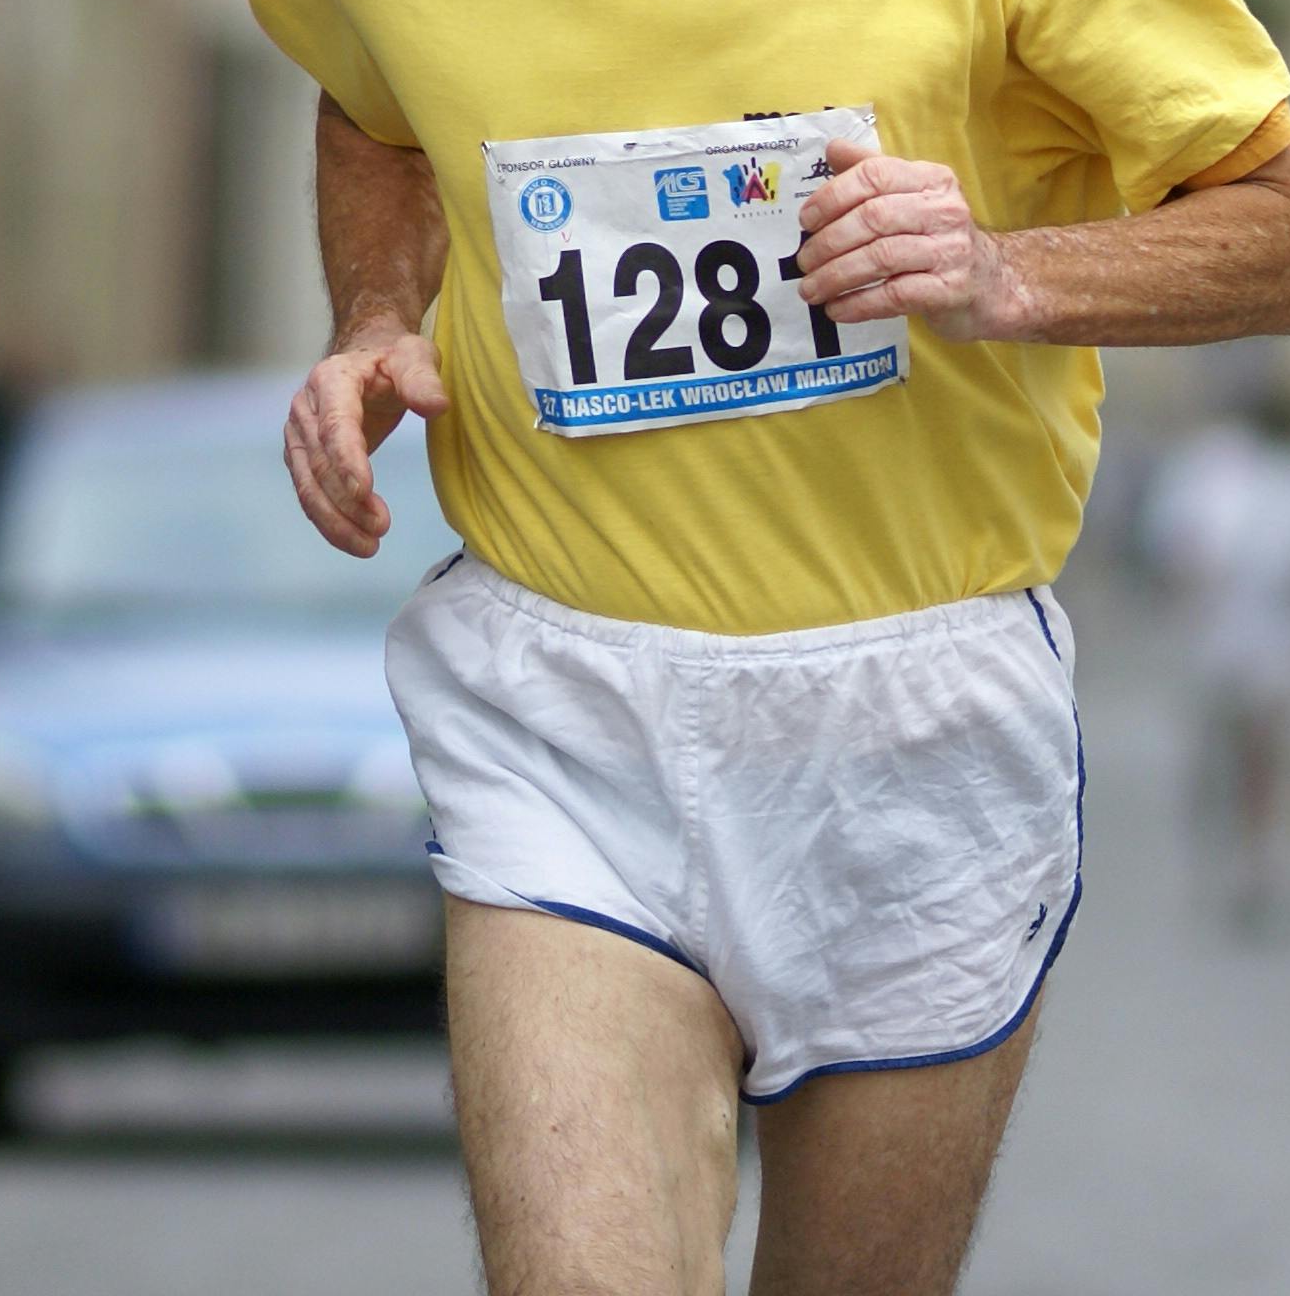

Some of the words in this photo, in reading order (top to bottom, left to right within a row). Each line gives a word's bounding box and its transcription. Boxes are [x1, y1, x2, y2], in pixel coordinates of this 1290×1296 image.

[705, 138, 800, 155] ORGANIZATORZY
[563, 389, 677, 418] HASCO-LEK
[680, 371, 790, 407] WROCŁAW
[795, 353, 894, 389] MARATON
